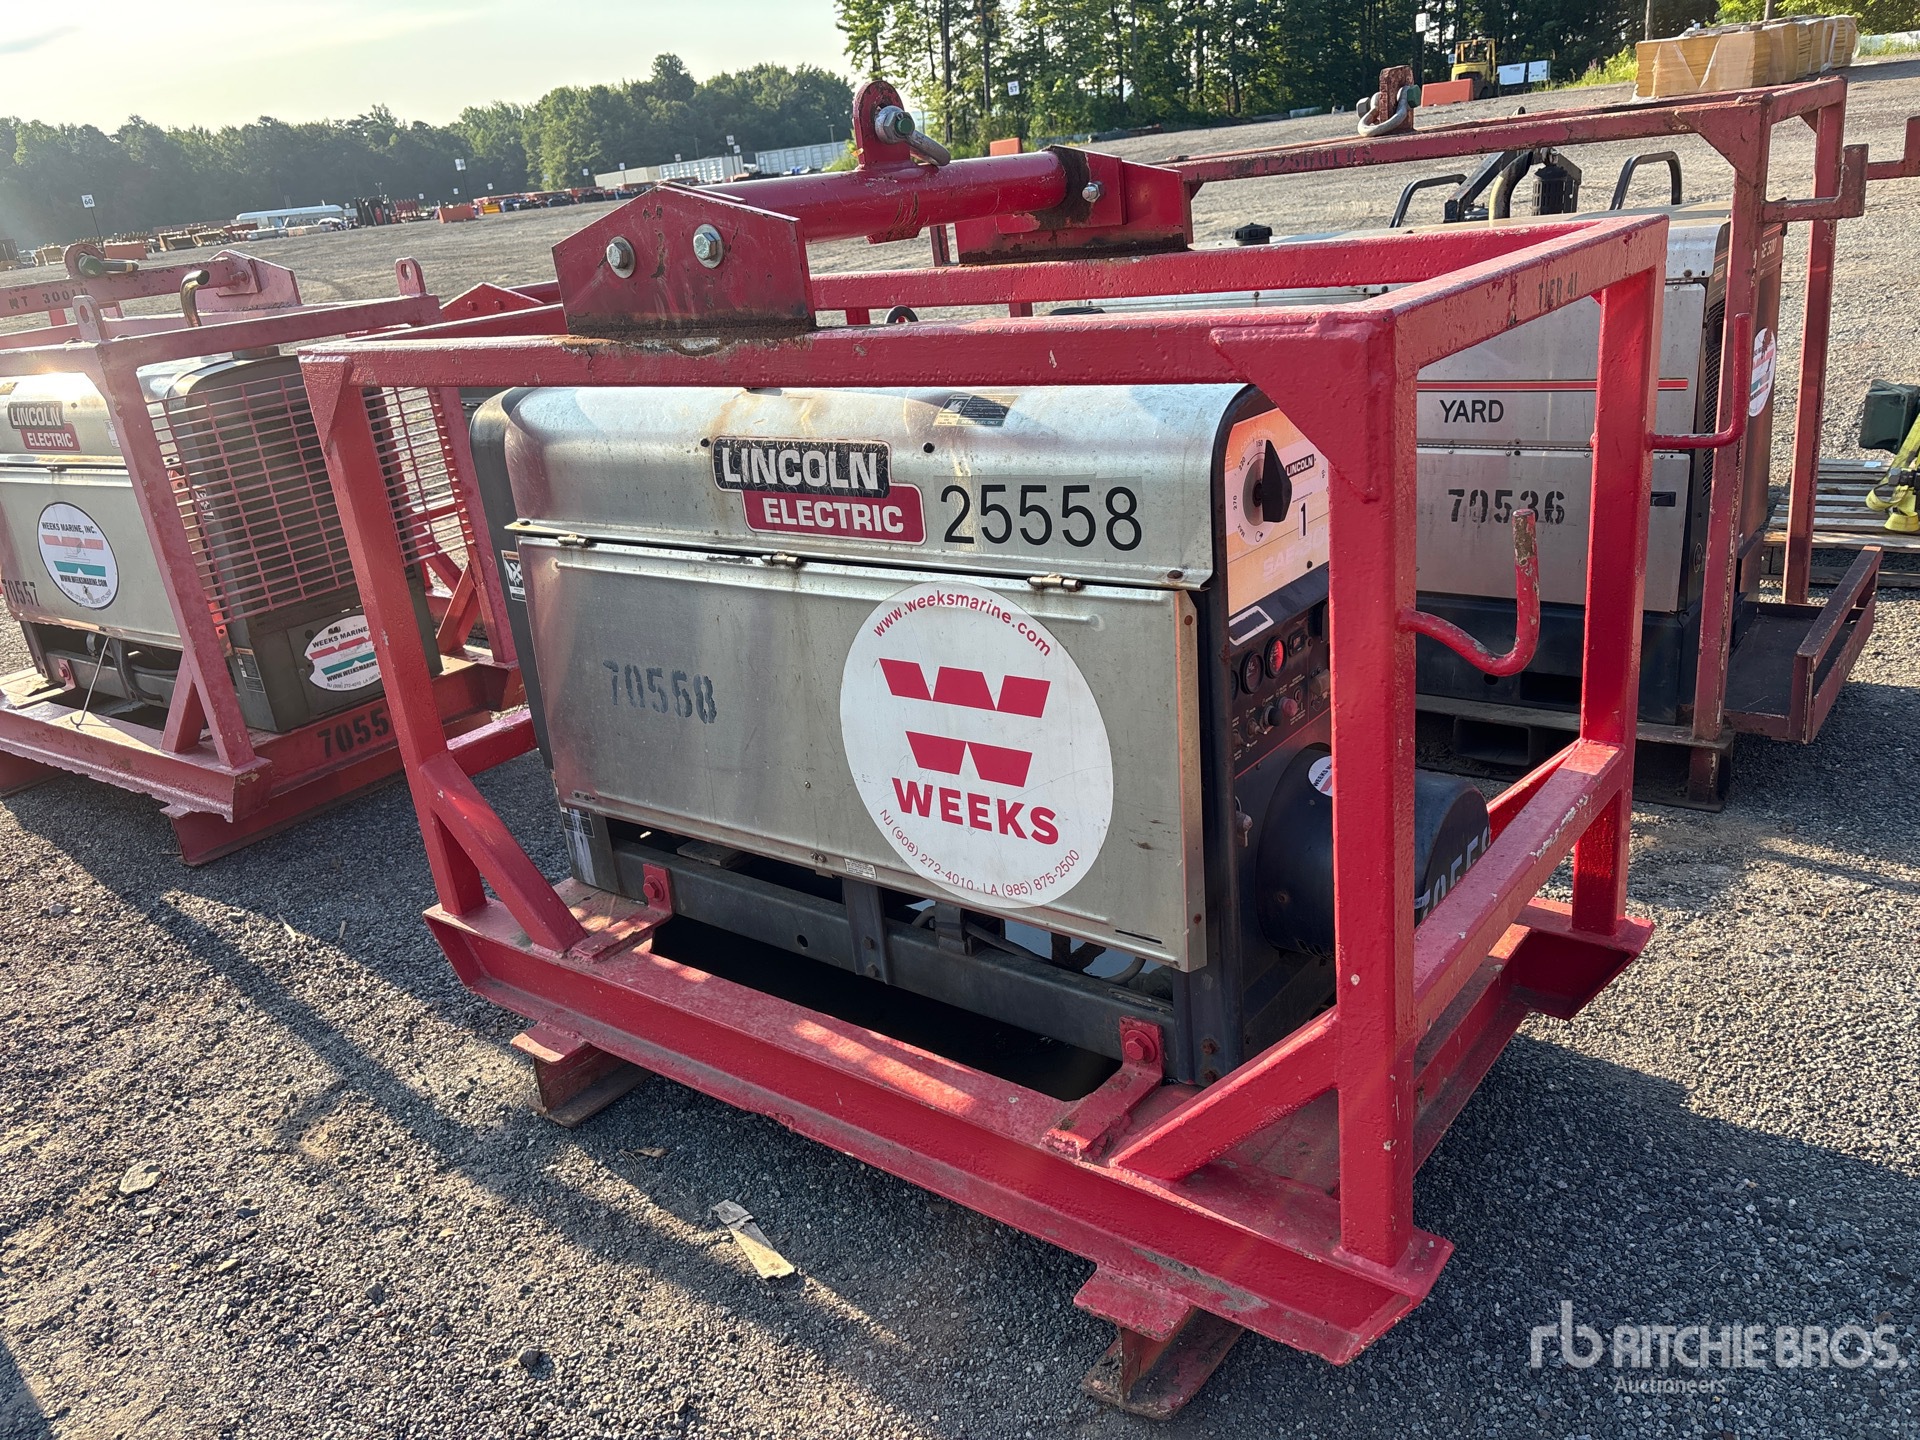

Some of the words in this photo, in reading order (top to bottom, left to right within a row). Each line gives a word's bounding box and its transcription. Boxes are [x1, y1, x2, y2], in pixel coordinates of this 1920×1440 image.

[11, 407, 62, 426] LINCOLN
[1439, 399, 1504, 423] YARD
[27, 432, 73, 447] ELECTRIC
[720, 447, 877, 490] LINCOLN
[1286, 456, 1314, 477] LINCOLN
[763, 497, 904, 534] ELECTRIC
[940, 484, 1142, 550] 25558
[1301, 502, 1306, 536] 1
[1448, 488, 1565, 524] 70536
[41, 522, 60, 531] WEEKS
[85, 525, 97, 534] INC.
[873, 589, 1051, 657] www.weeksmarine.com
[312, 634, 339, 648] WEEKS
[1313, 770, 1329, 787] WEEKS
[892, 777, 1059, 845] WEEKS
[880, 809, 894, 827] NJ
[892, 825, 919, 858] (908)
[920, 853, 974, 891] 272-4010
[983, 882, 999, 896] LA
[1001, 882, 1033, 899] (985)
[1034, 849, 1080, 892] 875-2500
